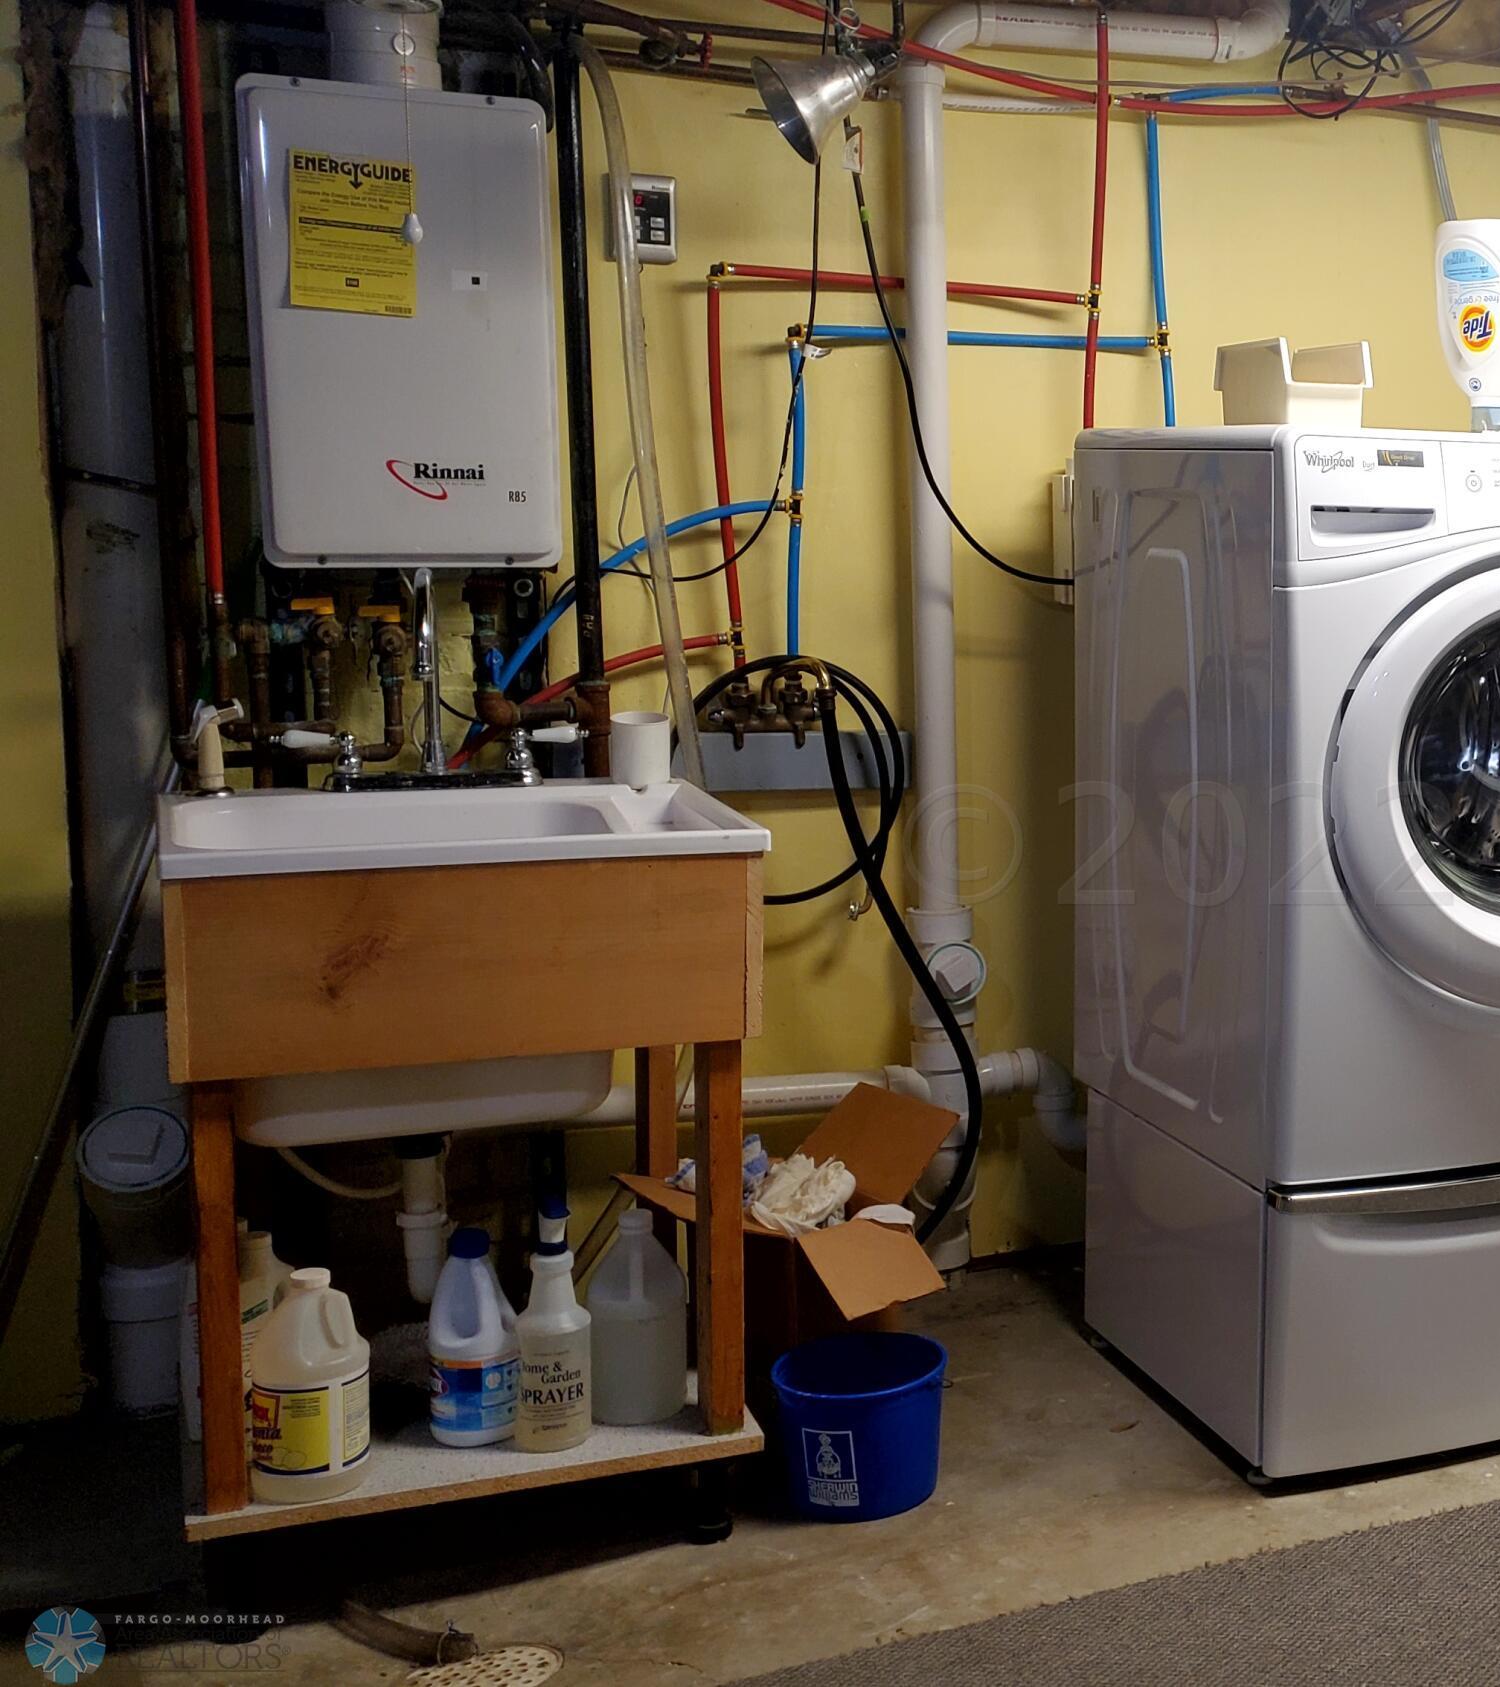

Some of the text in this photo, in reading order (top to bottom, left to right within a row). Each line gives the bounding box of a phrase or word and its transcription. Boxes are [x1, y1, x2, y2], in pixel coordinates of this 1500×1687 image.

[1463, 310, 1493, 340] Tide
[1303, 450, 1355, 473] Whirlpool
[413, 462, 485, 480] Rinnai
[508, 490, 527, 503] R85
[553, 1361, 562, 1373] &
[540, 1370, 581, 1384] Garden
